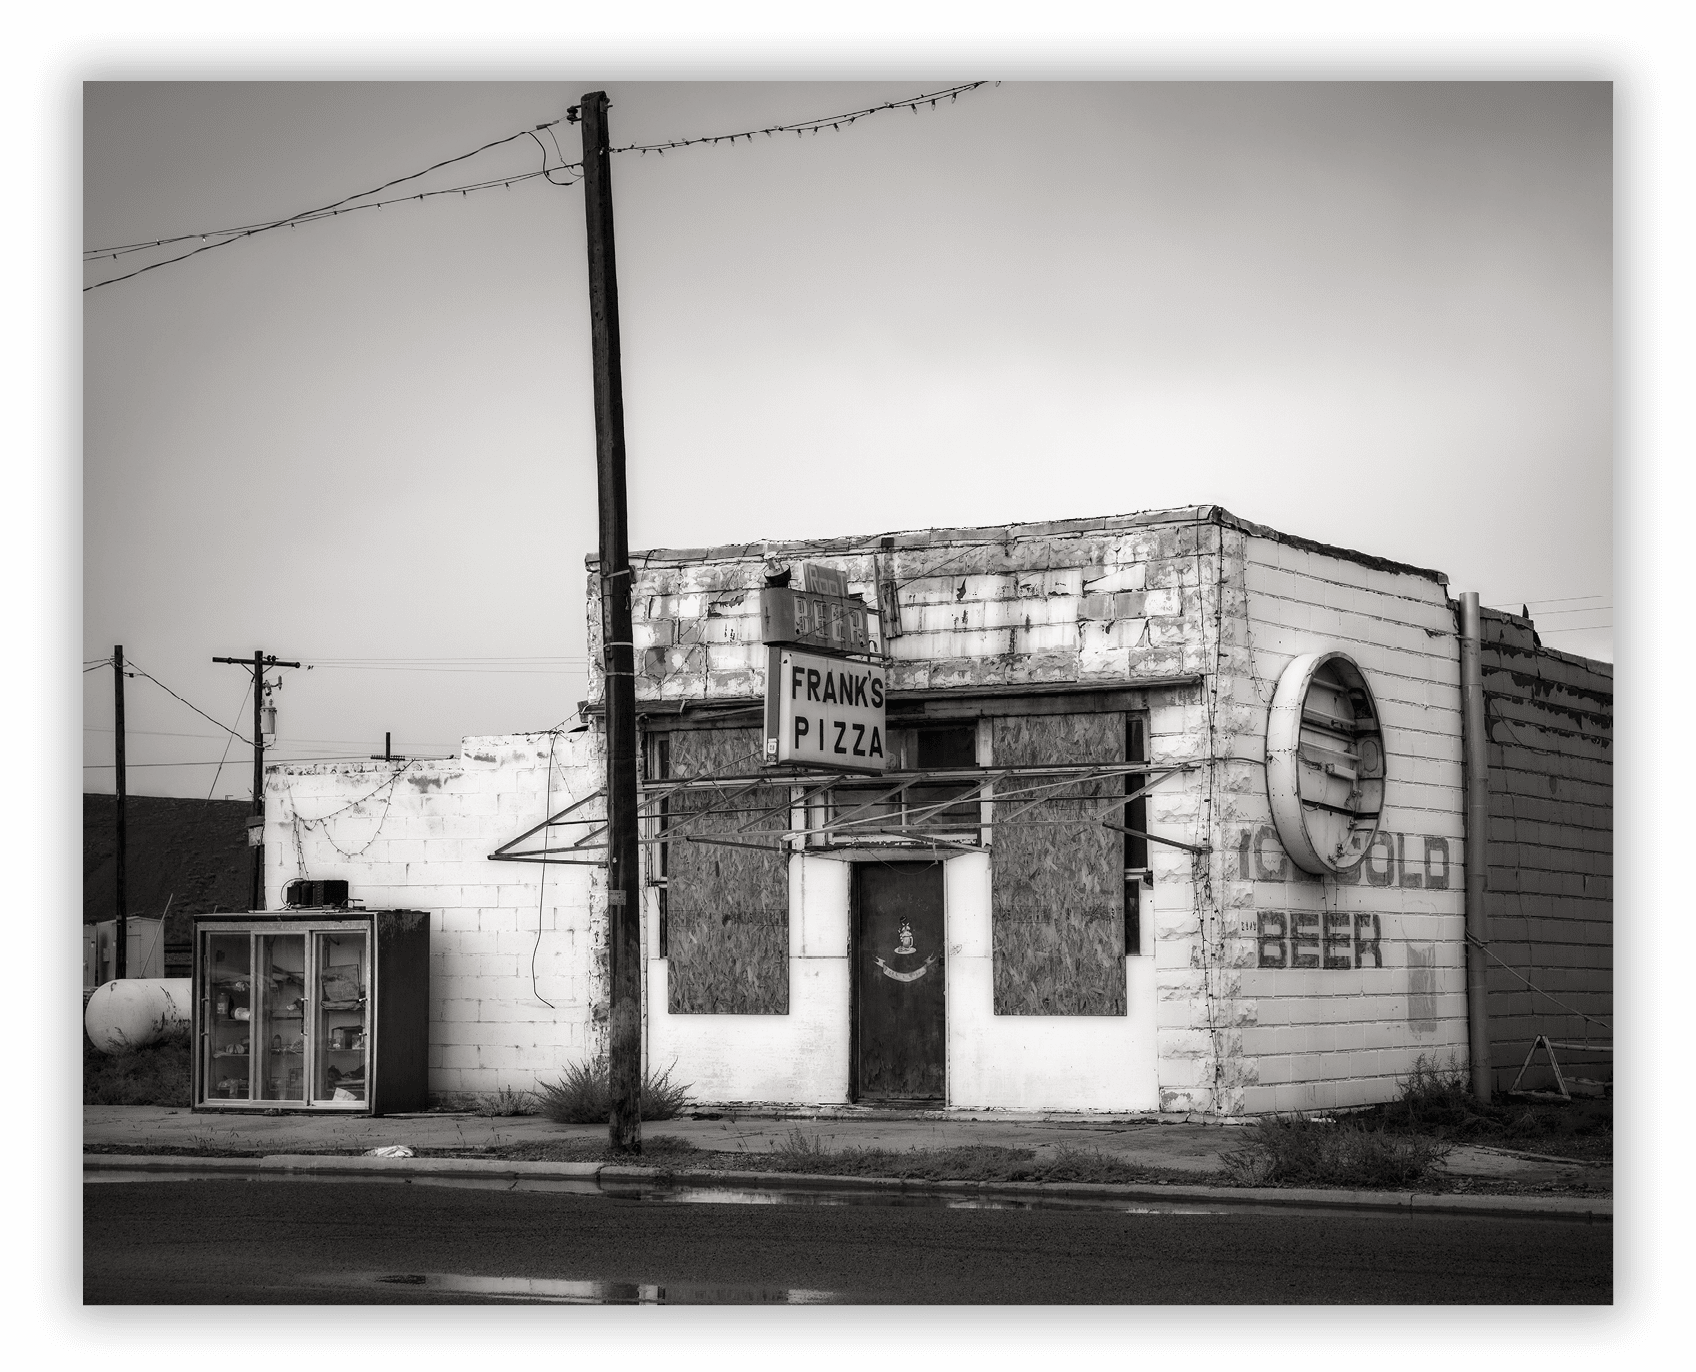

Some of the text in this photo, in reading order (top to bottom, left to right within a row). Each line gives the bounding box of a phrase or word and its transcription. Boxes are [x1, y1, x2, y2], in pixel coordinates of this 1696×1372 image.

[793, 594, 866, 648] BEER
[791, 665, 884, 709] FRANK'S
[793, 715, 884, 759] PIZZA
[1239, 824, 1324, 883] IC
[1256, 910, 1383, 969] BEER
